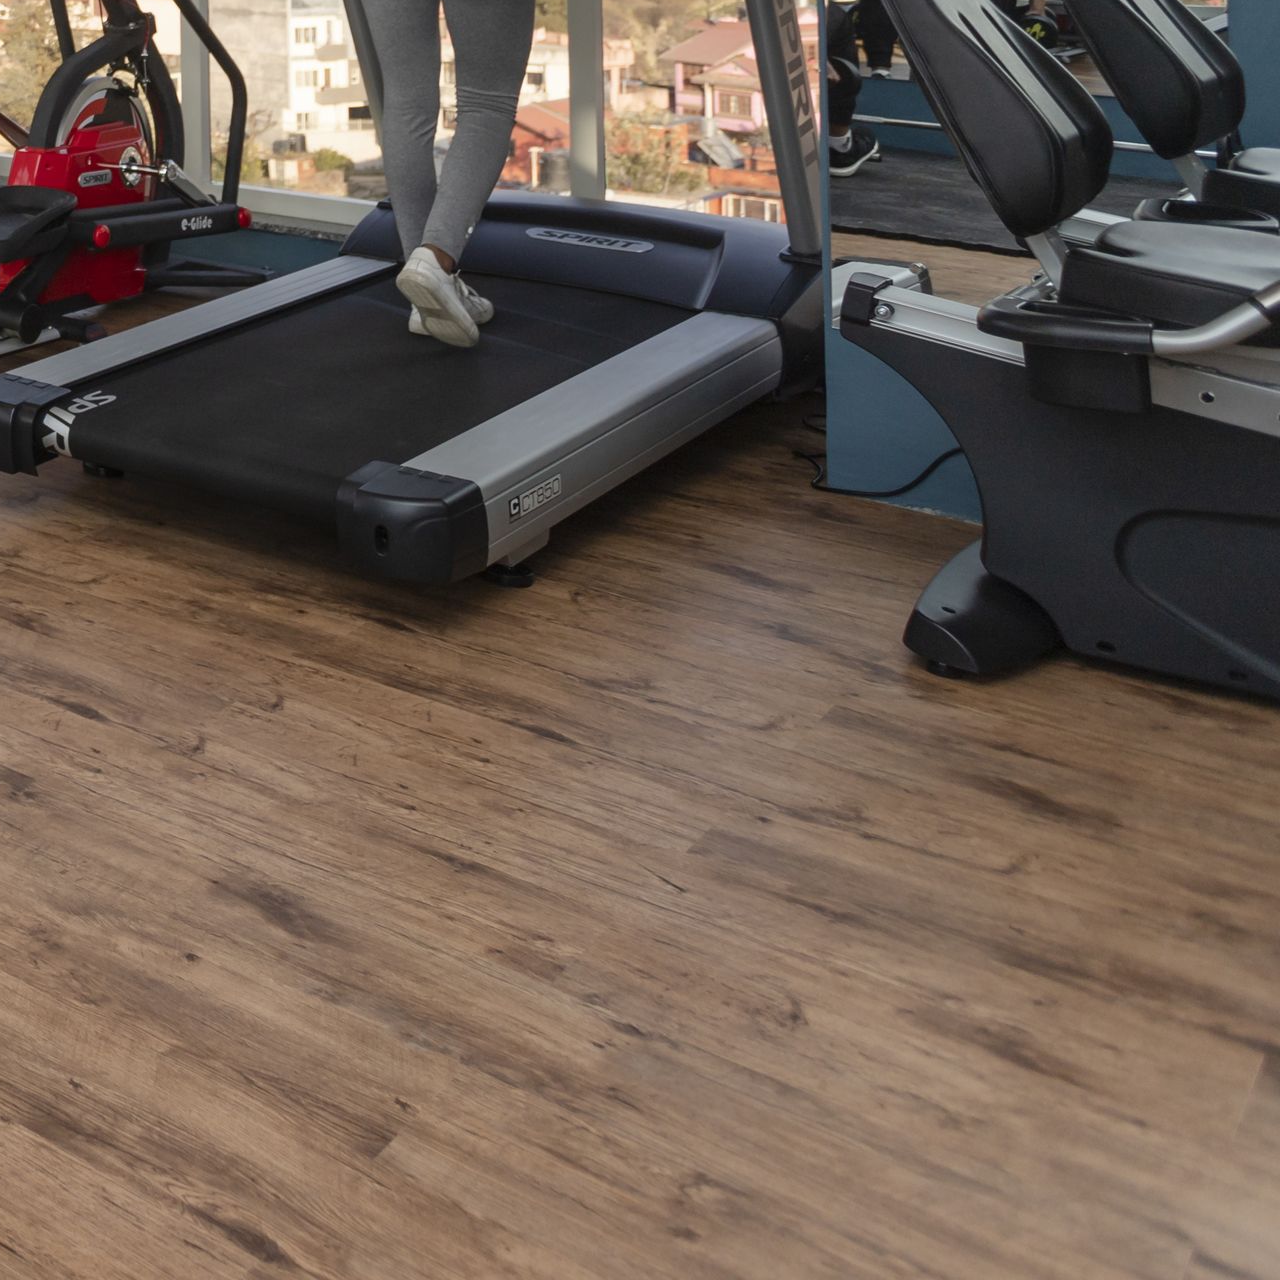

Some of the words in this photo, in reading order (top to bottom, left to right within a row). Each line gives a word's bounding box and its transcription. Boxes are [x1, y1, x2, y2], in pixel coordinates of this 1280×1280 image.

[83, 172, 110, 185] SPIRIT
[181, 216, 213, 231] e-Glide
[536, 230, 645, 248] SPIRIT
[41, 390, 117, 457] SPIR
[522, 477, 560, 513] CT850
